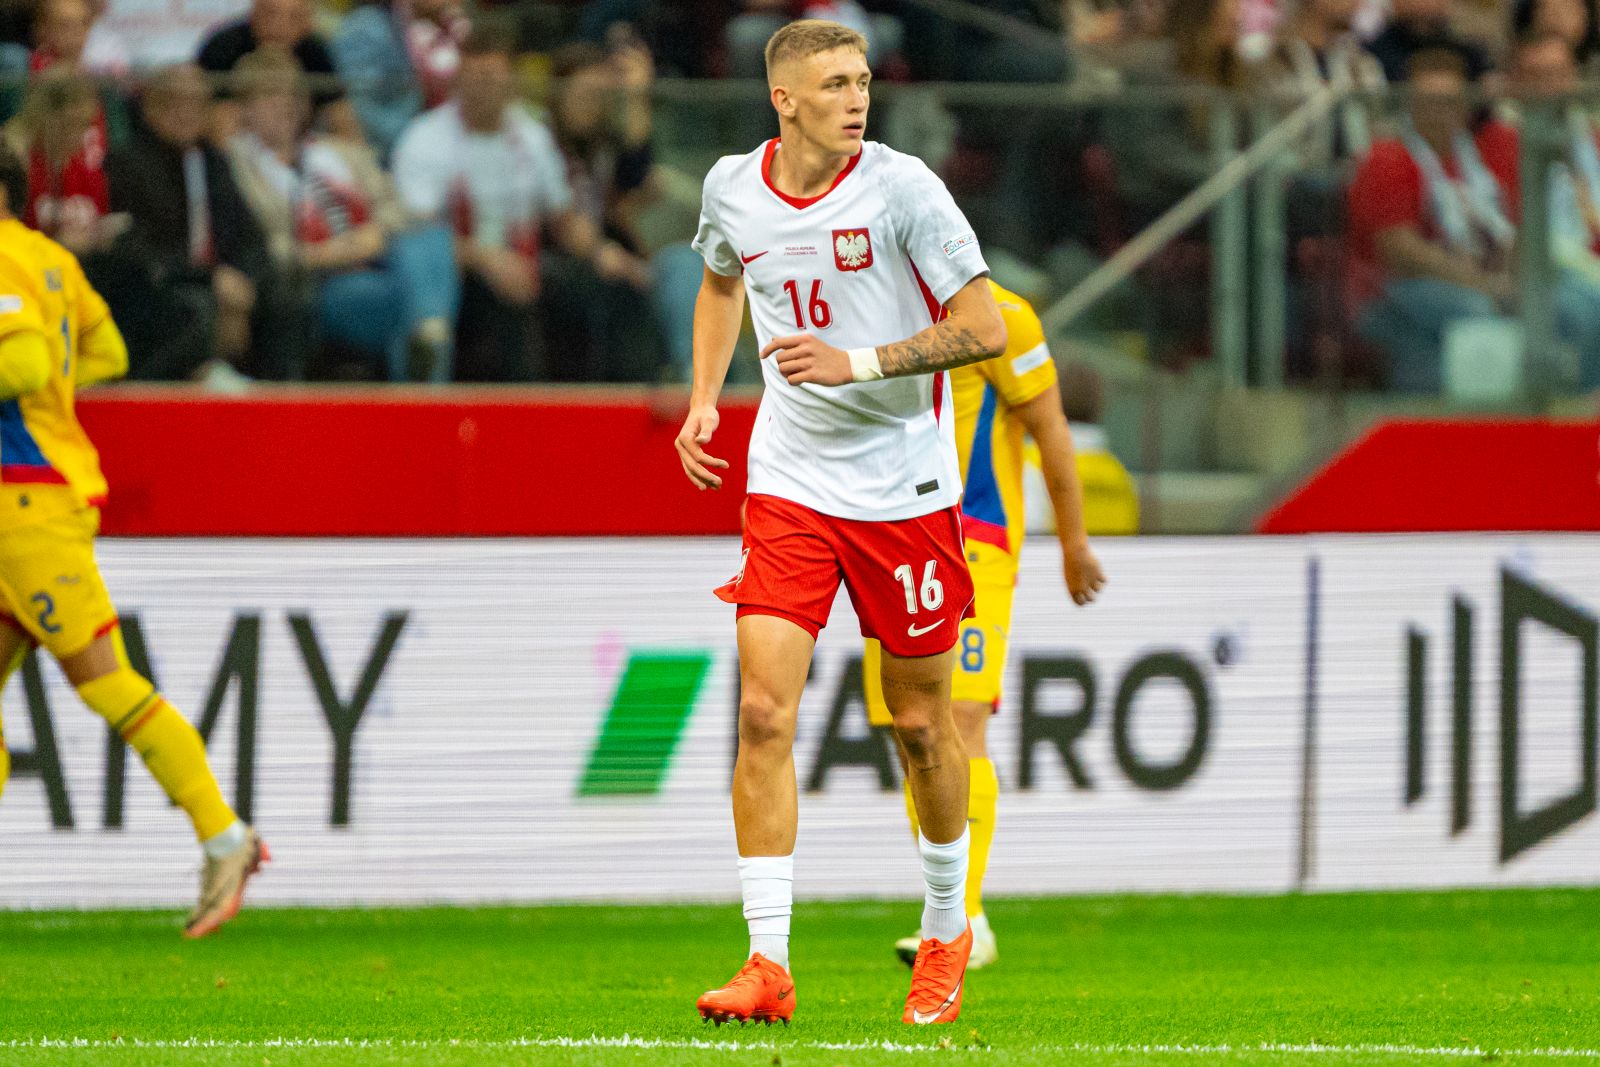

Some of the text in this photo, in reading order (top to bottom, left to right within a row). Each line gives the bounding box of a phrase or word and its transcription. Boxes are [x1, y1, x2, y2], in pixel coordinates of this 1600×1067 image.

[783, 279, 833, 330] 16
[32, 592, 62, 633] 2
[894, 559, 944, 615] 16
[961, 626, 985, 672] 8
[736, 650, 1213, 791] ARO
